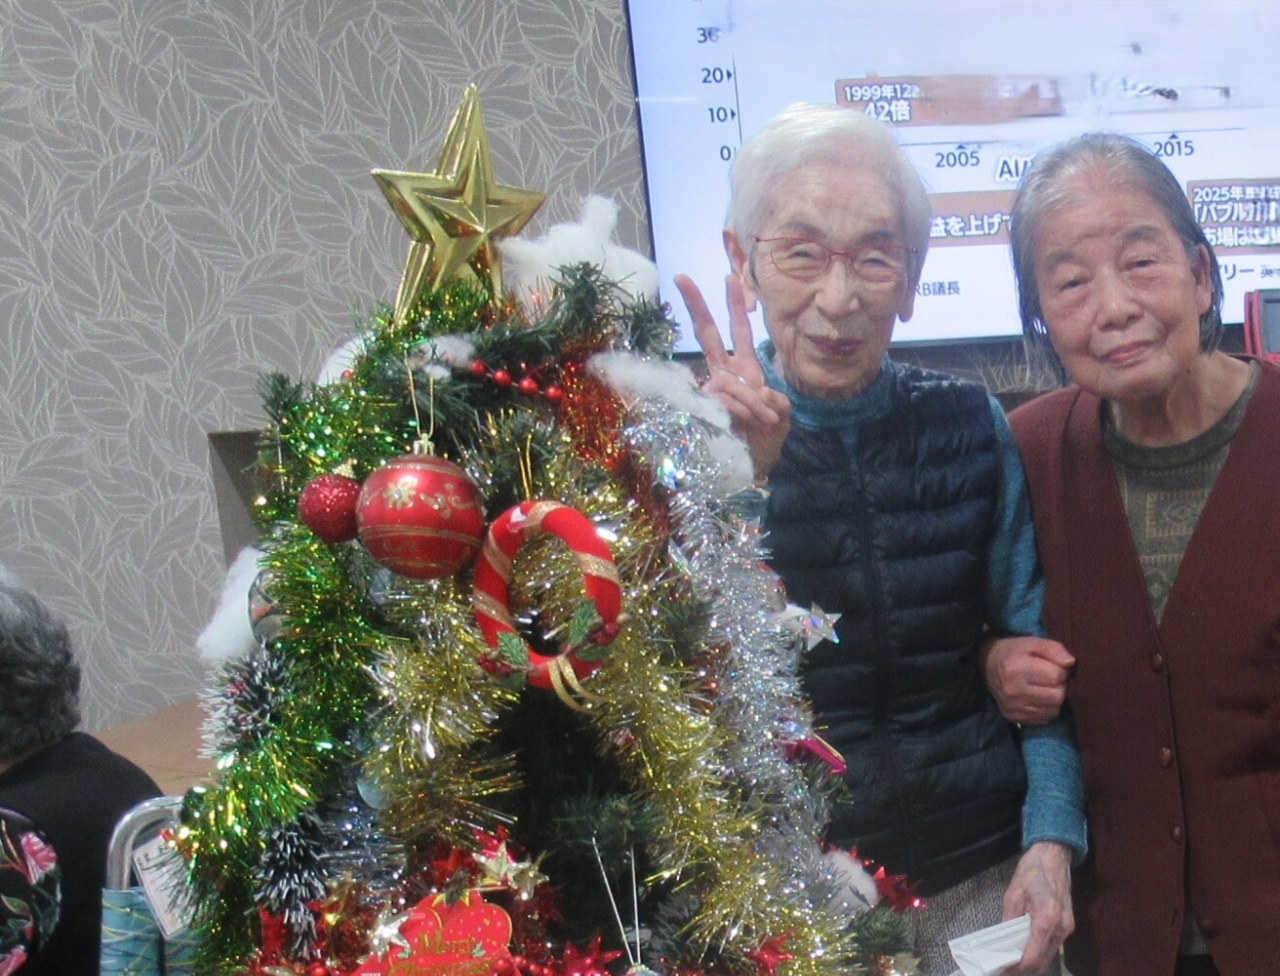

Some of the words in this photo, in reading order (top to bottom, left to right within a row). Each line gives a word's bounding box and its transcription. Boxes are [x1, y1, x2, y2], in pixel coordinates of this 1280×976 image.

[701, 67, 724, 83] 20
[708, 106, 728, 122] 10
[864, 100, 911, 122] 42倍
[720, 146, 731, 160] 0
[1154, 140, 1194, 157] 2015
[935, 151, 980, 168] 2005
